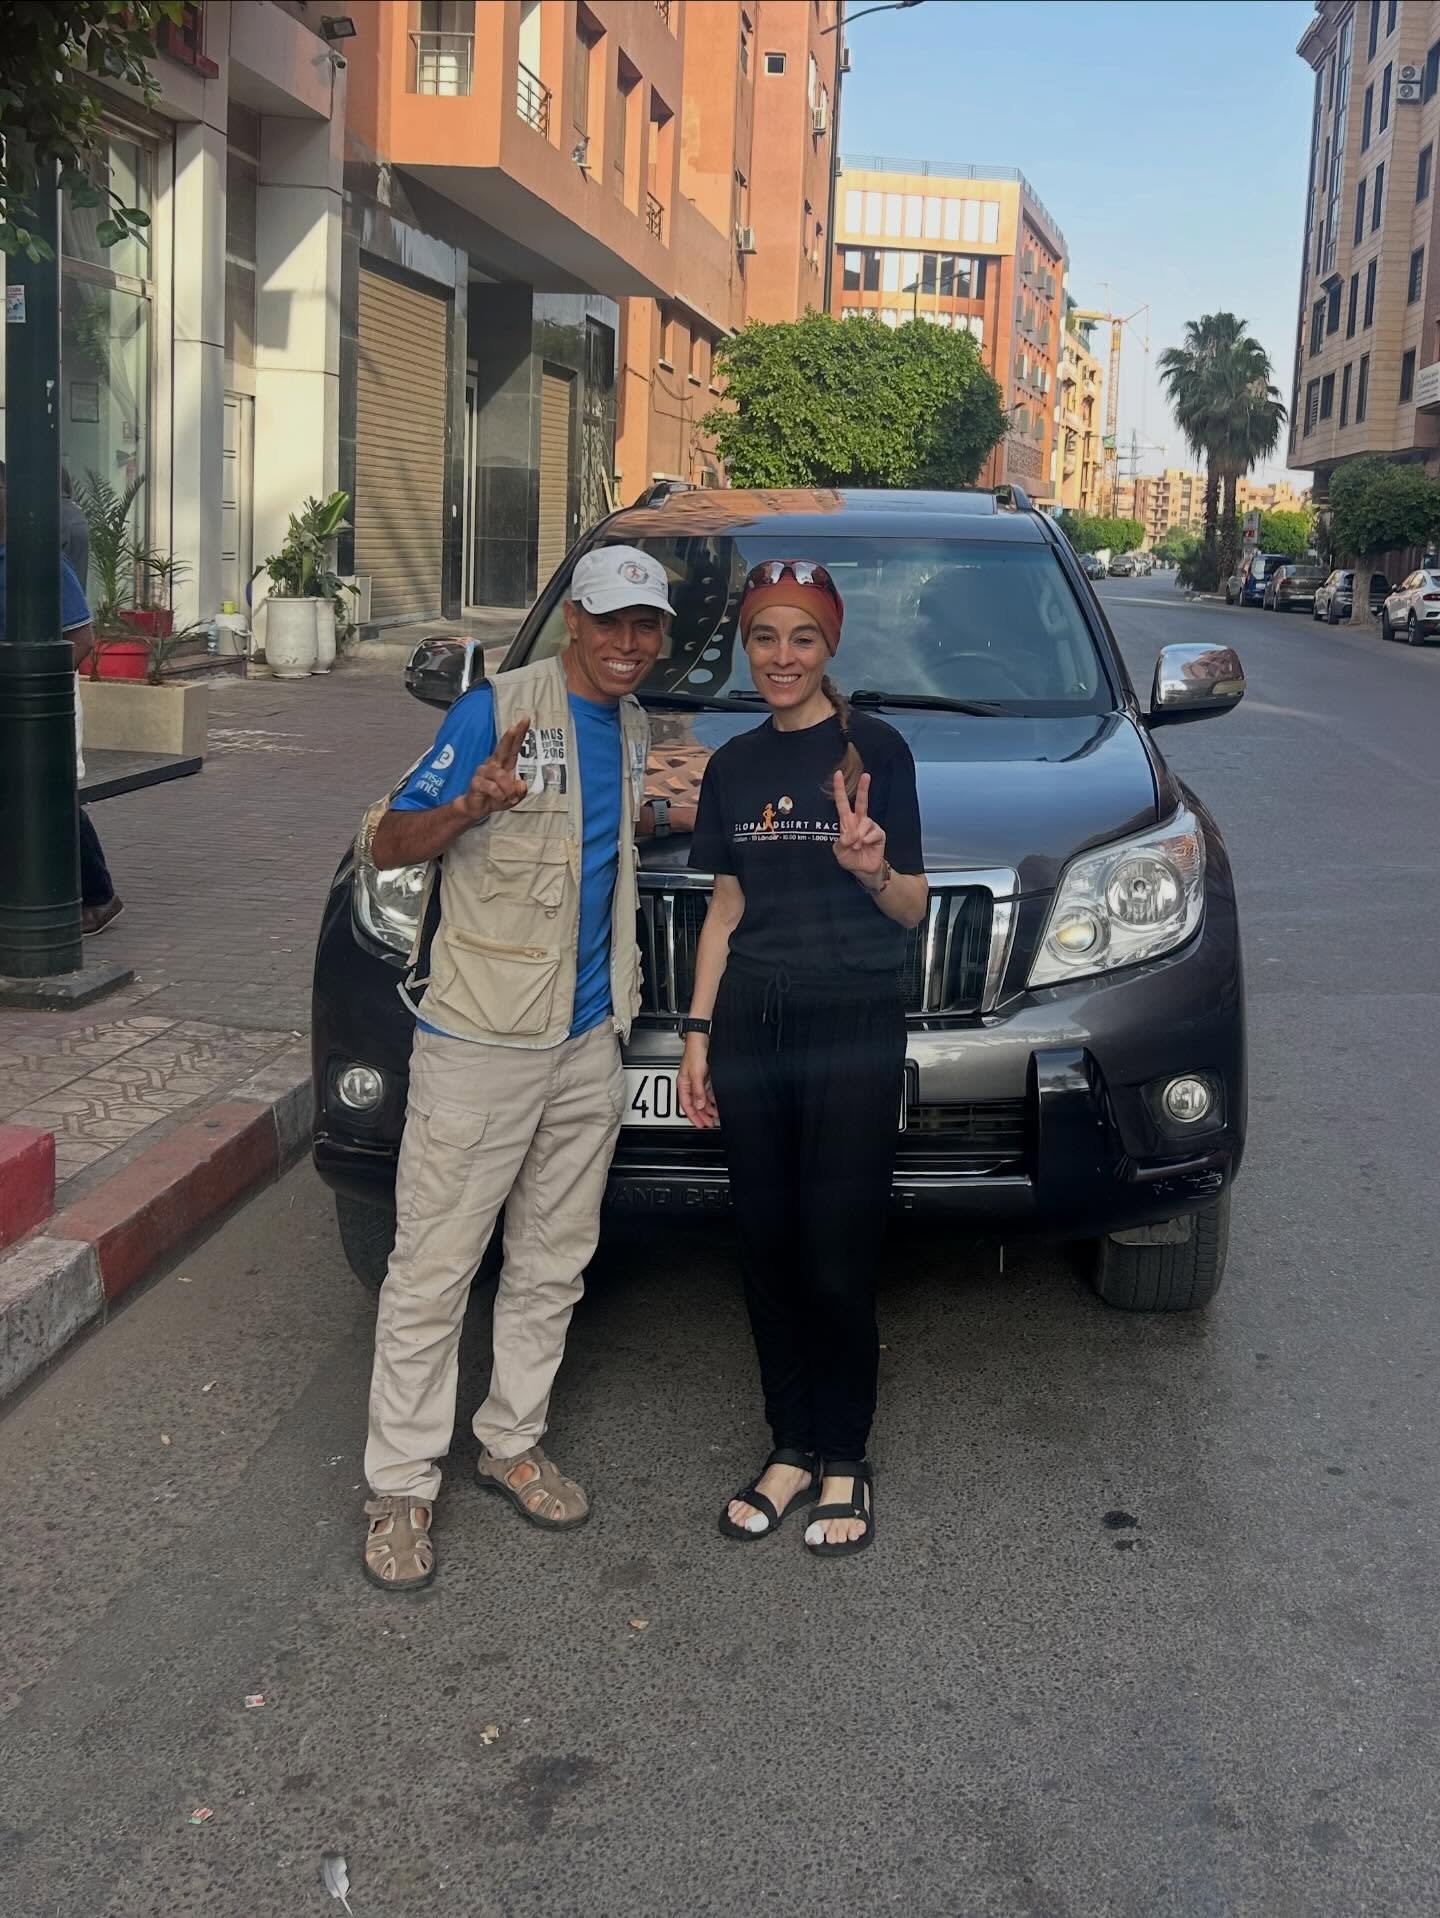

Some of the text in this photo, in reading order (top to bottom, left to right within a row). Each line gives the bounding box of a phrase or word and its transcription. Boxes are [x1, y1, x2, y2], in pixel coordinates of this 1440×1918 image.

[540, 728, 563, 741] MDS
[773, 820, 809, 829] DESERT
[815, 821, 839, 831] RAC
[631, 1075, 688, 1118] 40
